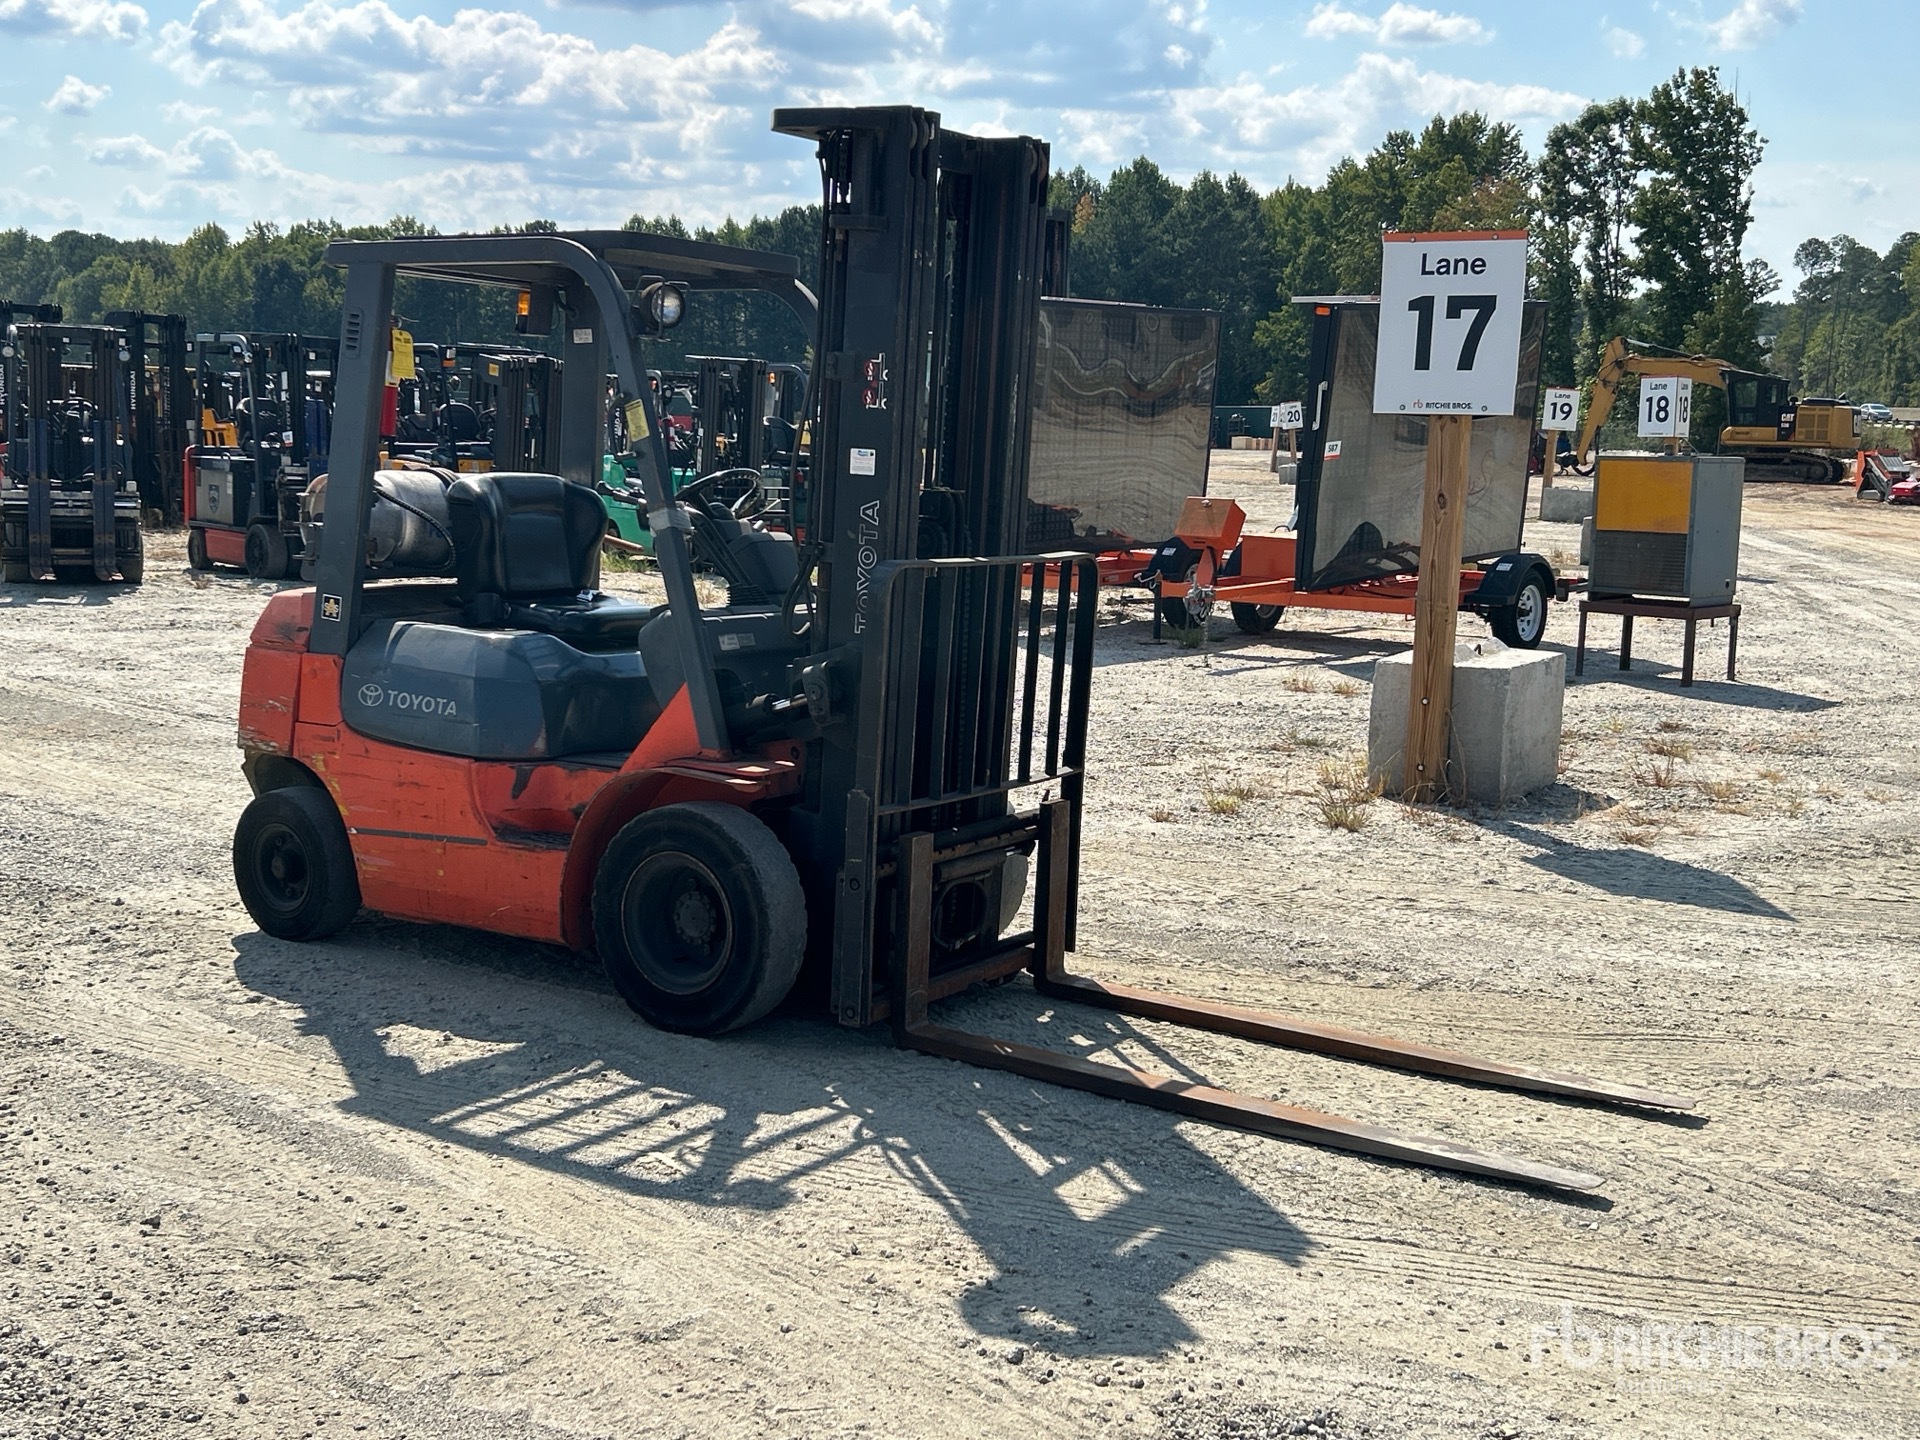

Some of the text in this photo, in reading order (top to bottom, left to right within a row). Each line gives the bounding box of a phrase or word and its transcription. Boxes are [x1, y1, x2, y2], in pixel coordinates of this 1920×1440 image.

[1420, 252, 1487, 276] Lane
[1407, 294, 1498, 371] 17
[1650, 382, 1668, 390] Lane
[1287, 410, 1300, 423] 20
[1425, 402, 1451, 410] RITCHIE
[1452, 402, 1473, 410] BROS.
[1550, 402, 1573, 421] 19
[1645, 395, 1670, 423] 18
[1679, 396, 1689, 423] 18
[1781, 413, 1795, 422] CAT
[387, 689, 457, 716] TOYOTA
